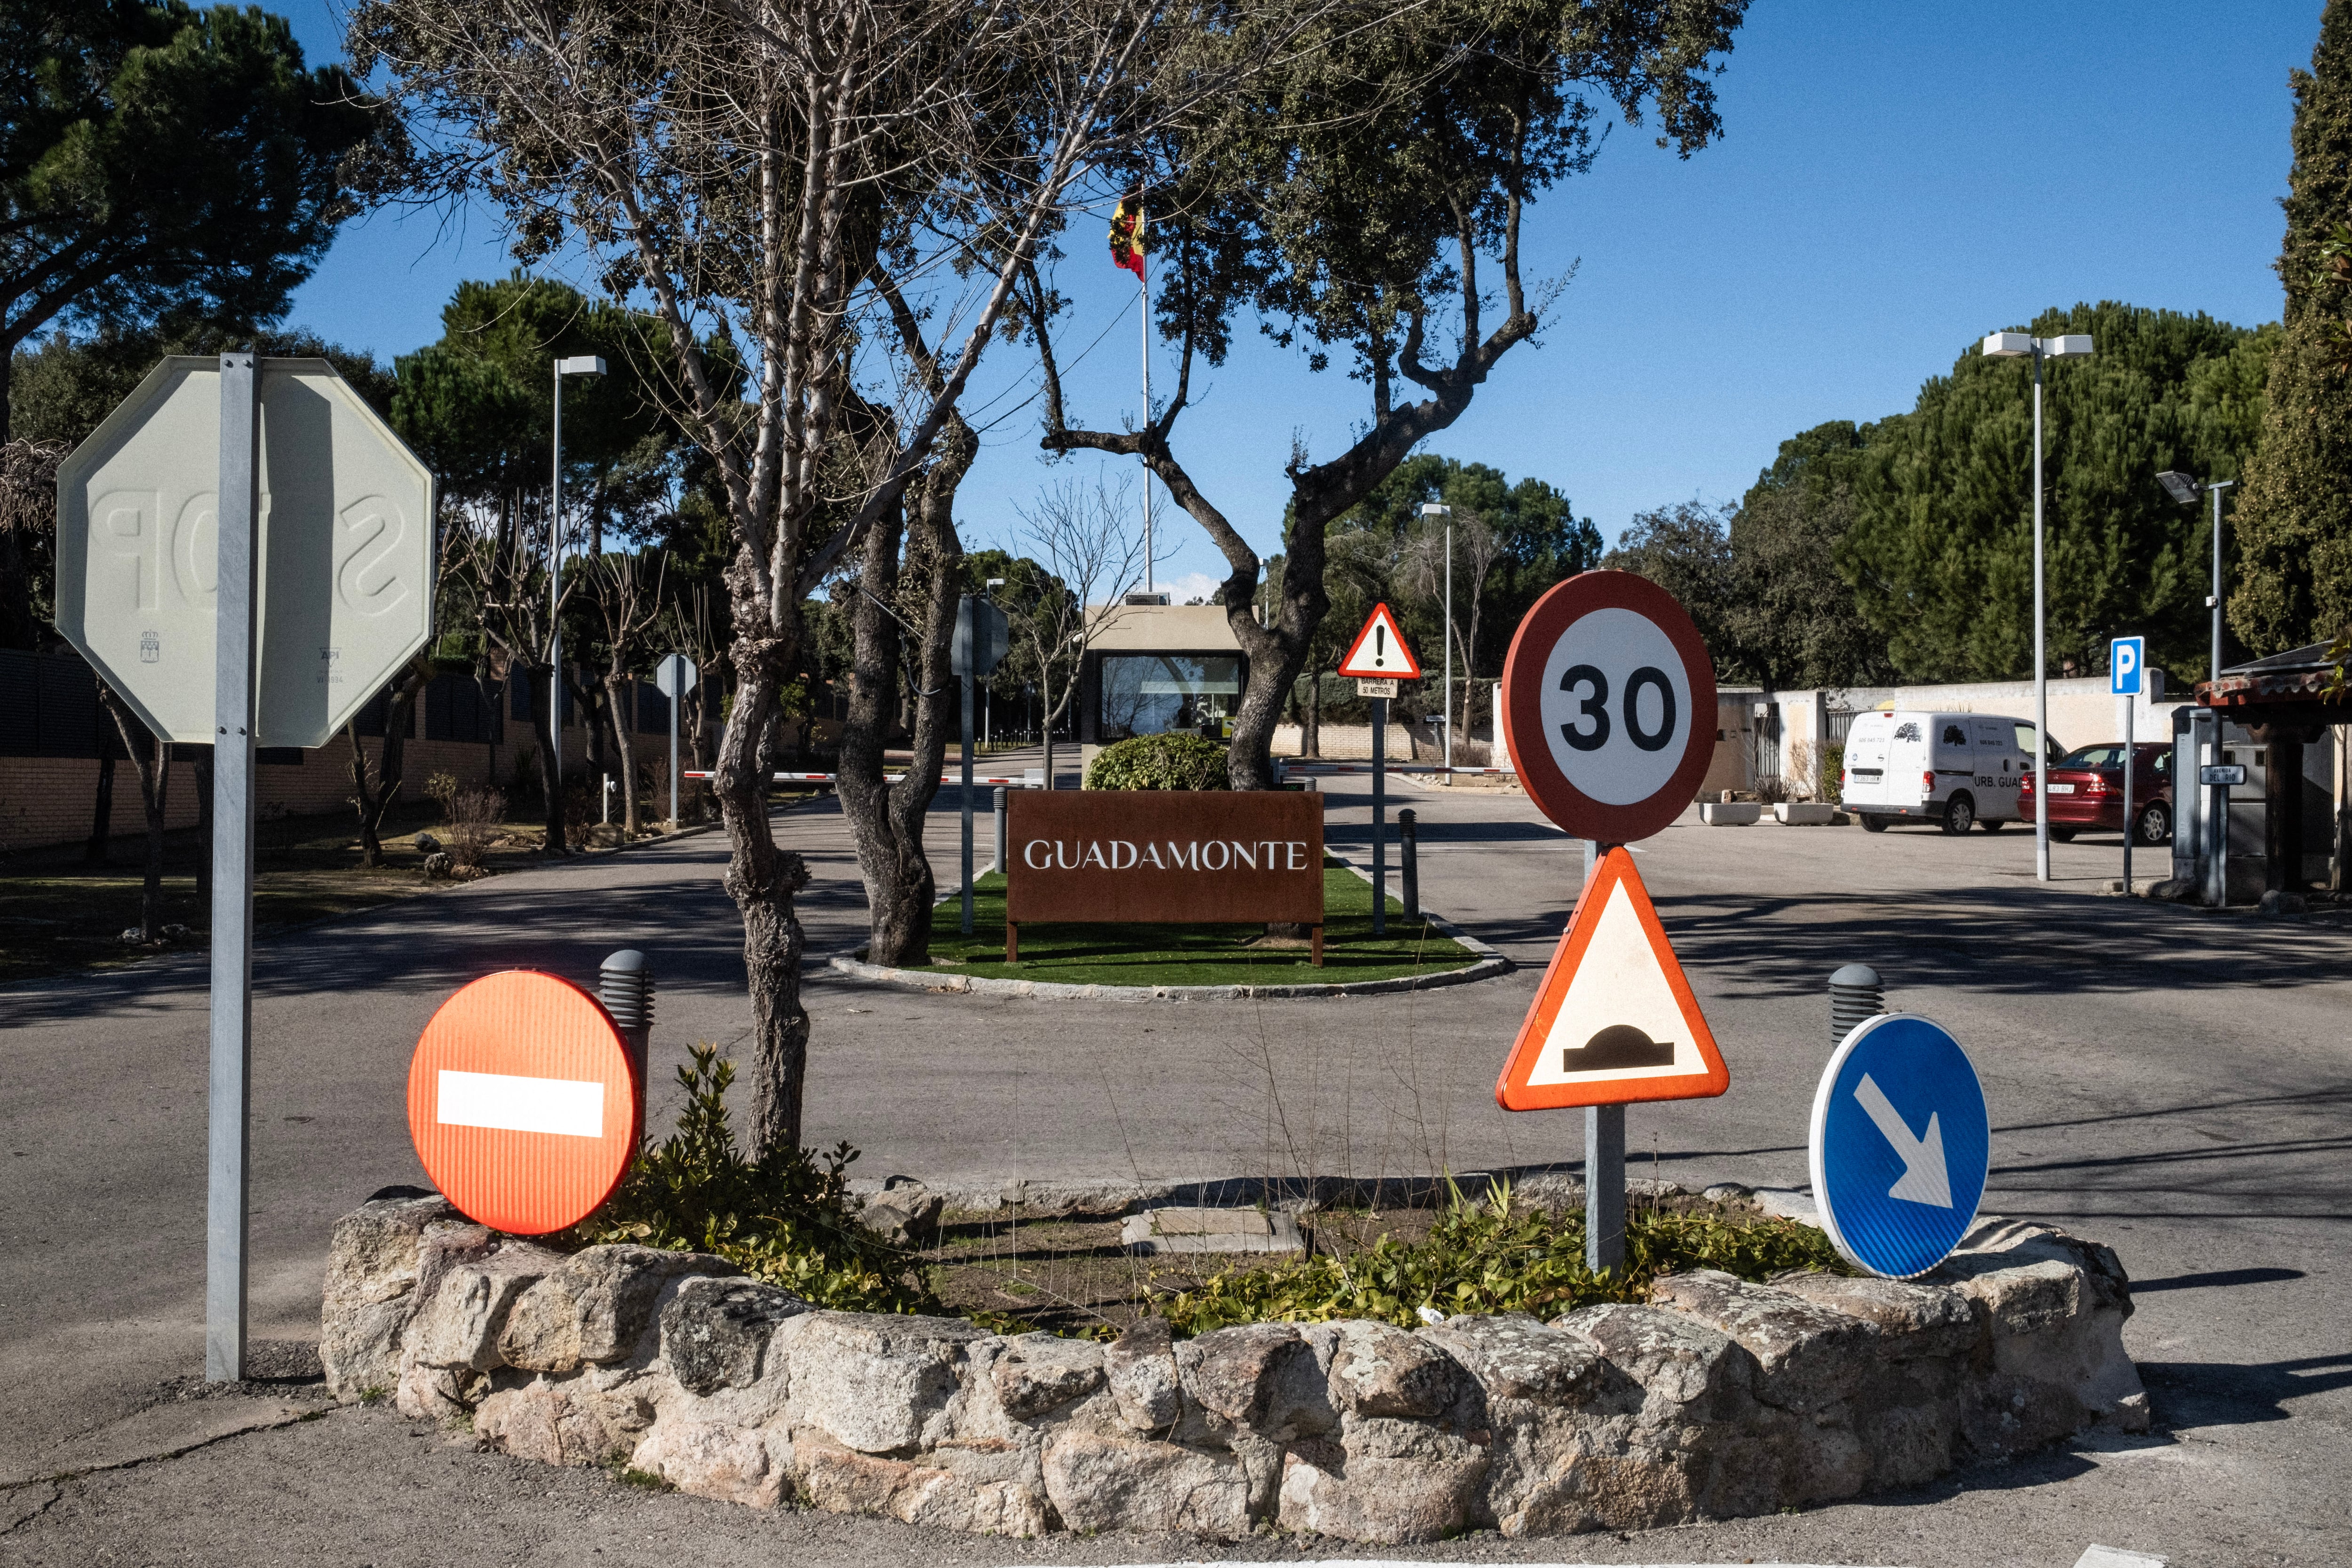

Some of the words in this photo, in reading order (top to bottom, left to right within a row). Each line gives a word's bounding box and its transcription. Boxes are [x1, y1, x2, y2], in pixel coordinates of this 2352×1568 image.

[2116, 644, 2136, 689] P
[1559, 664, 1676, 752] 30
[1974, 776, 1995, 787] URB.
[2225, 773, 2236, 782] RIO
[1024, 839, 1308, 871] GUADAMONTE
